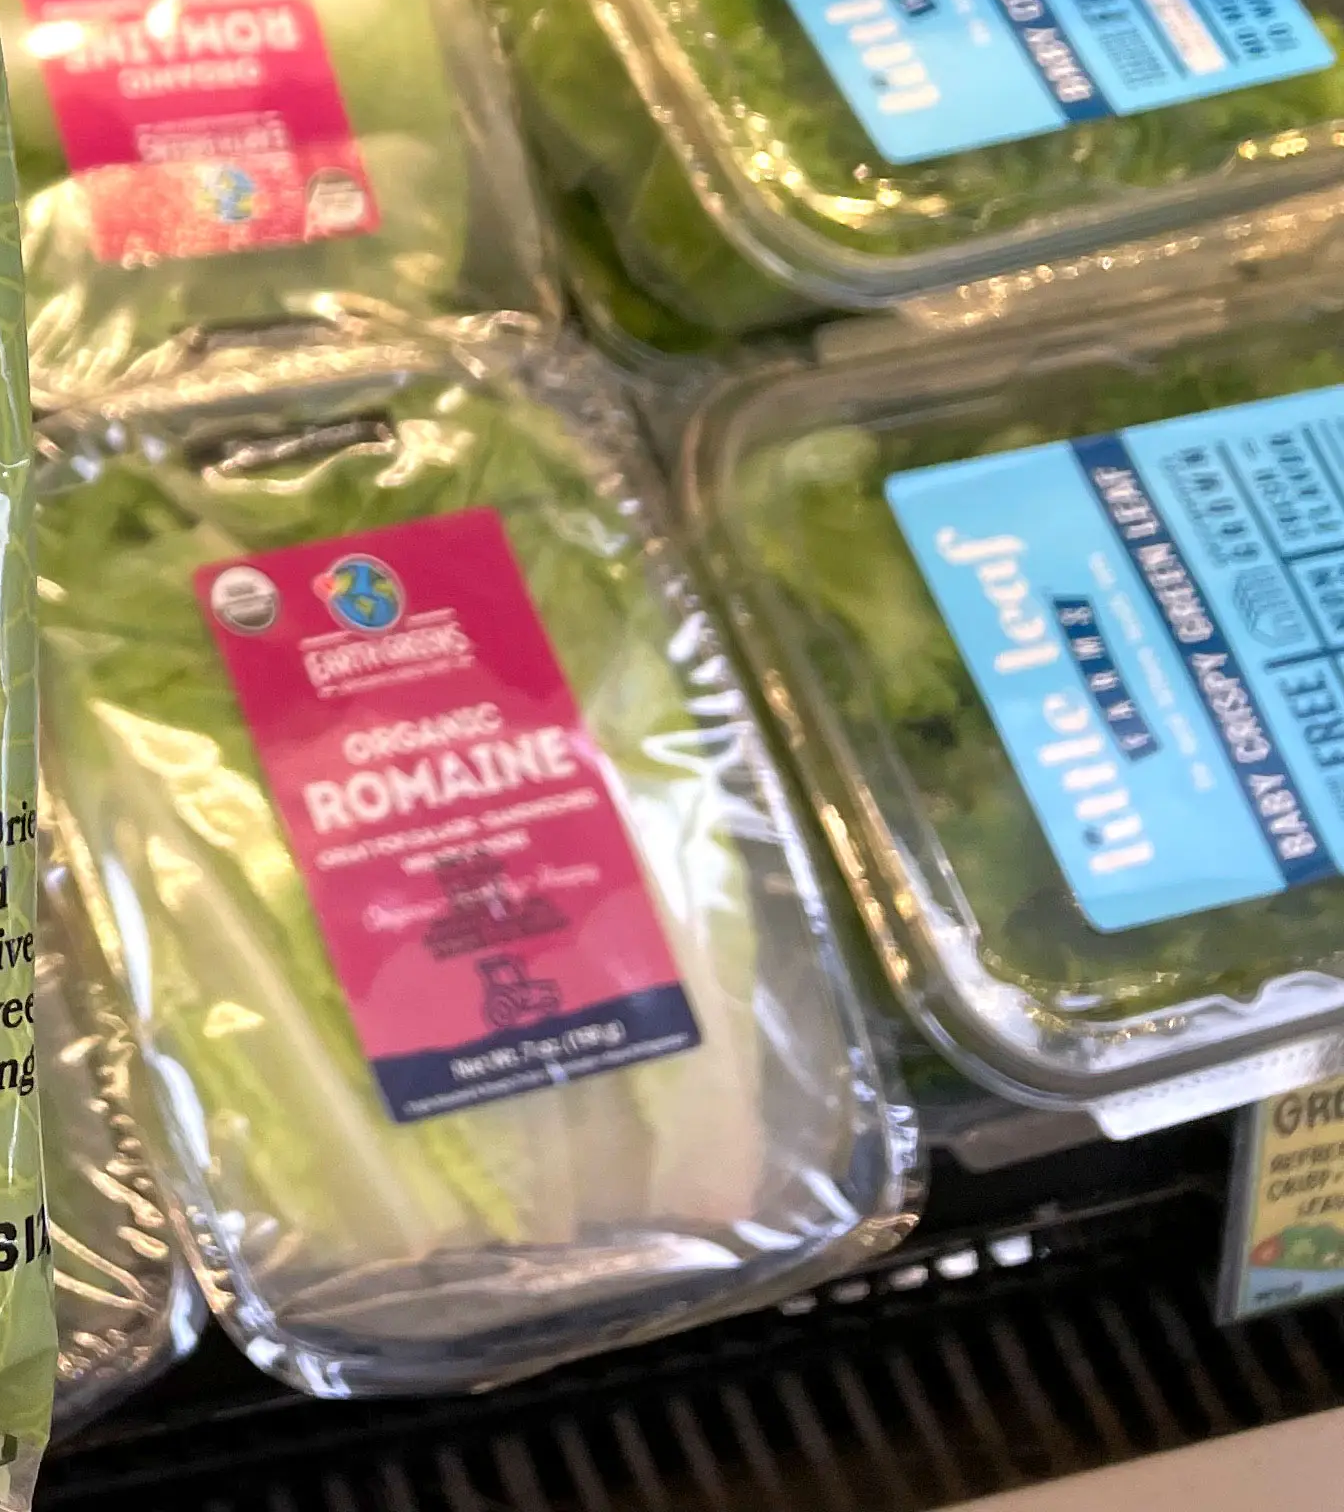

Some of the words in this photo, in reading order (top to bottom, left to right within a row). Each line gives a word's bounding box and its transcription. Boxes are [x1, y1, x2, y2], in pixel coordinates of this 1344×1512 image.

[936, 525, 1061, 675] leaf
[304, 726, 578, 835] ROMAINE
[341, 701, 502, 767] ORGANIC
[1037, 691, 1155, 874] little
[1249, 773, 1318, 861] BABY
